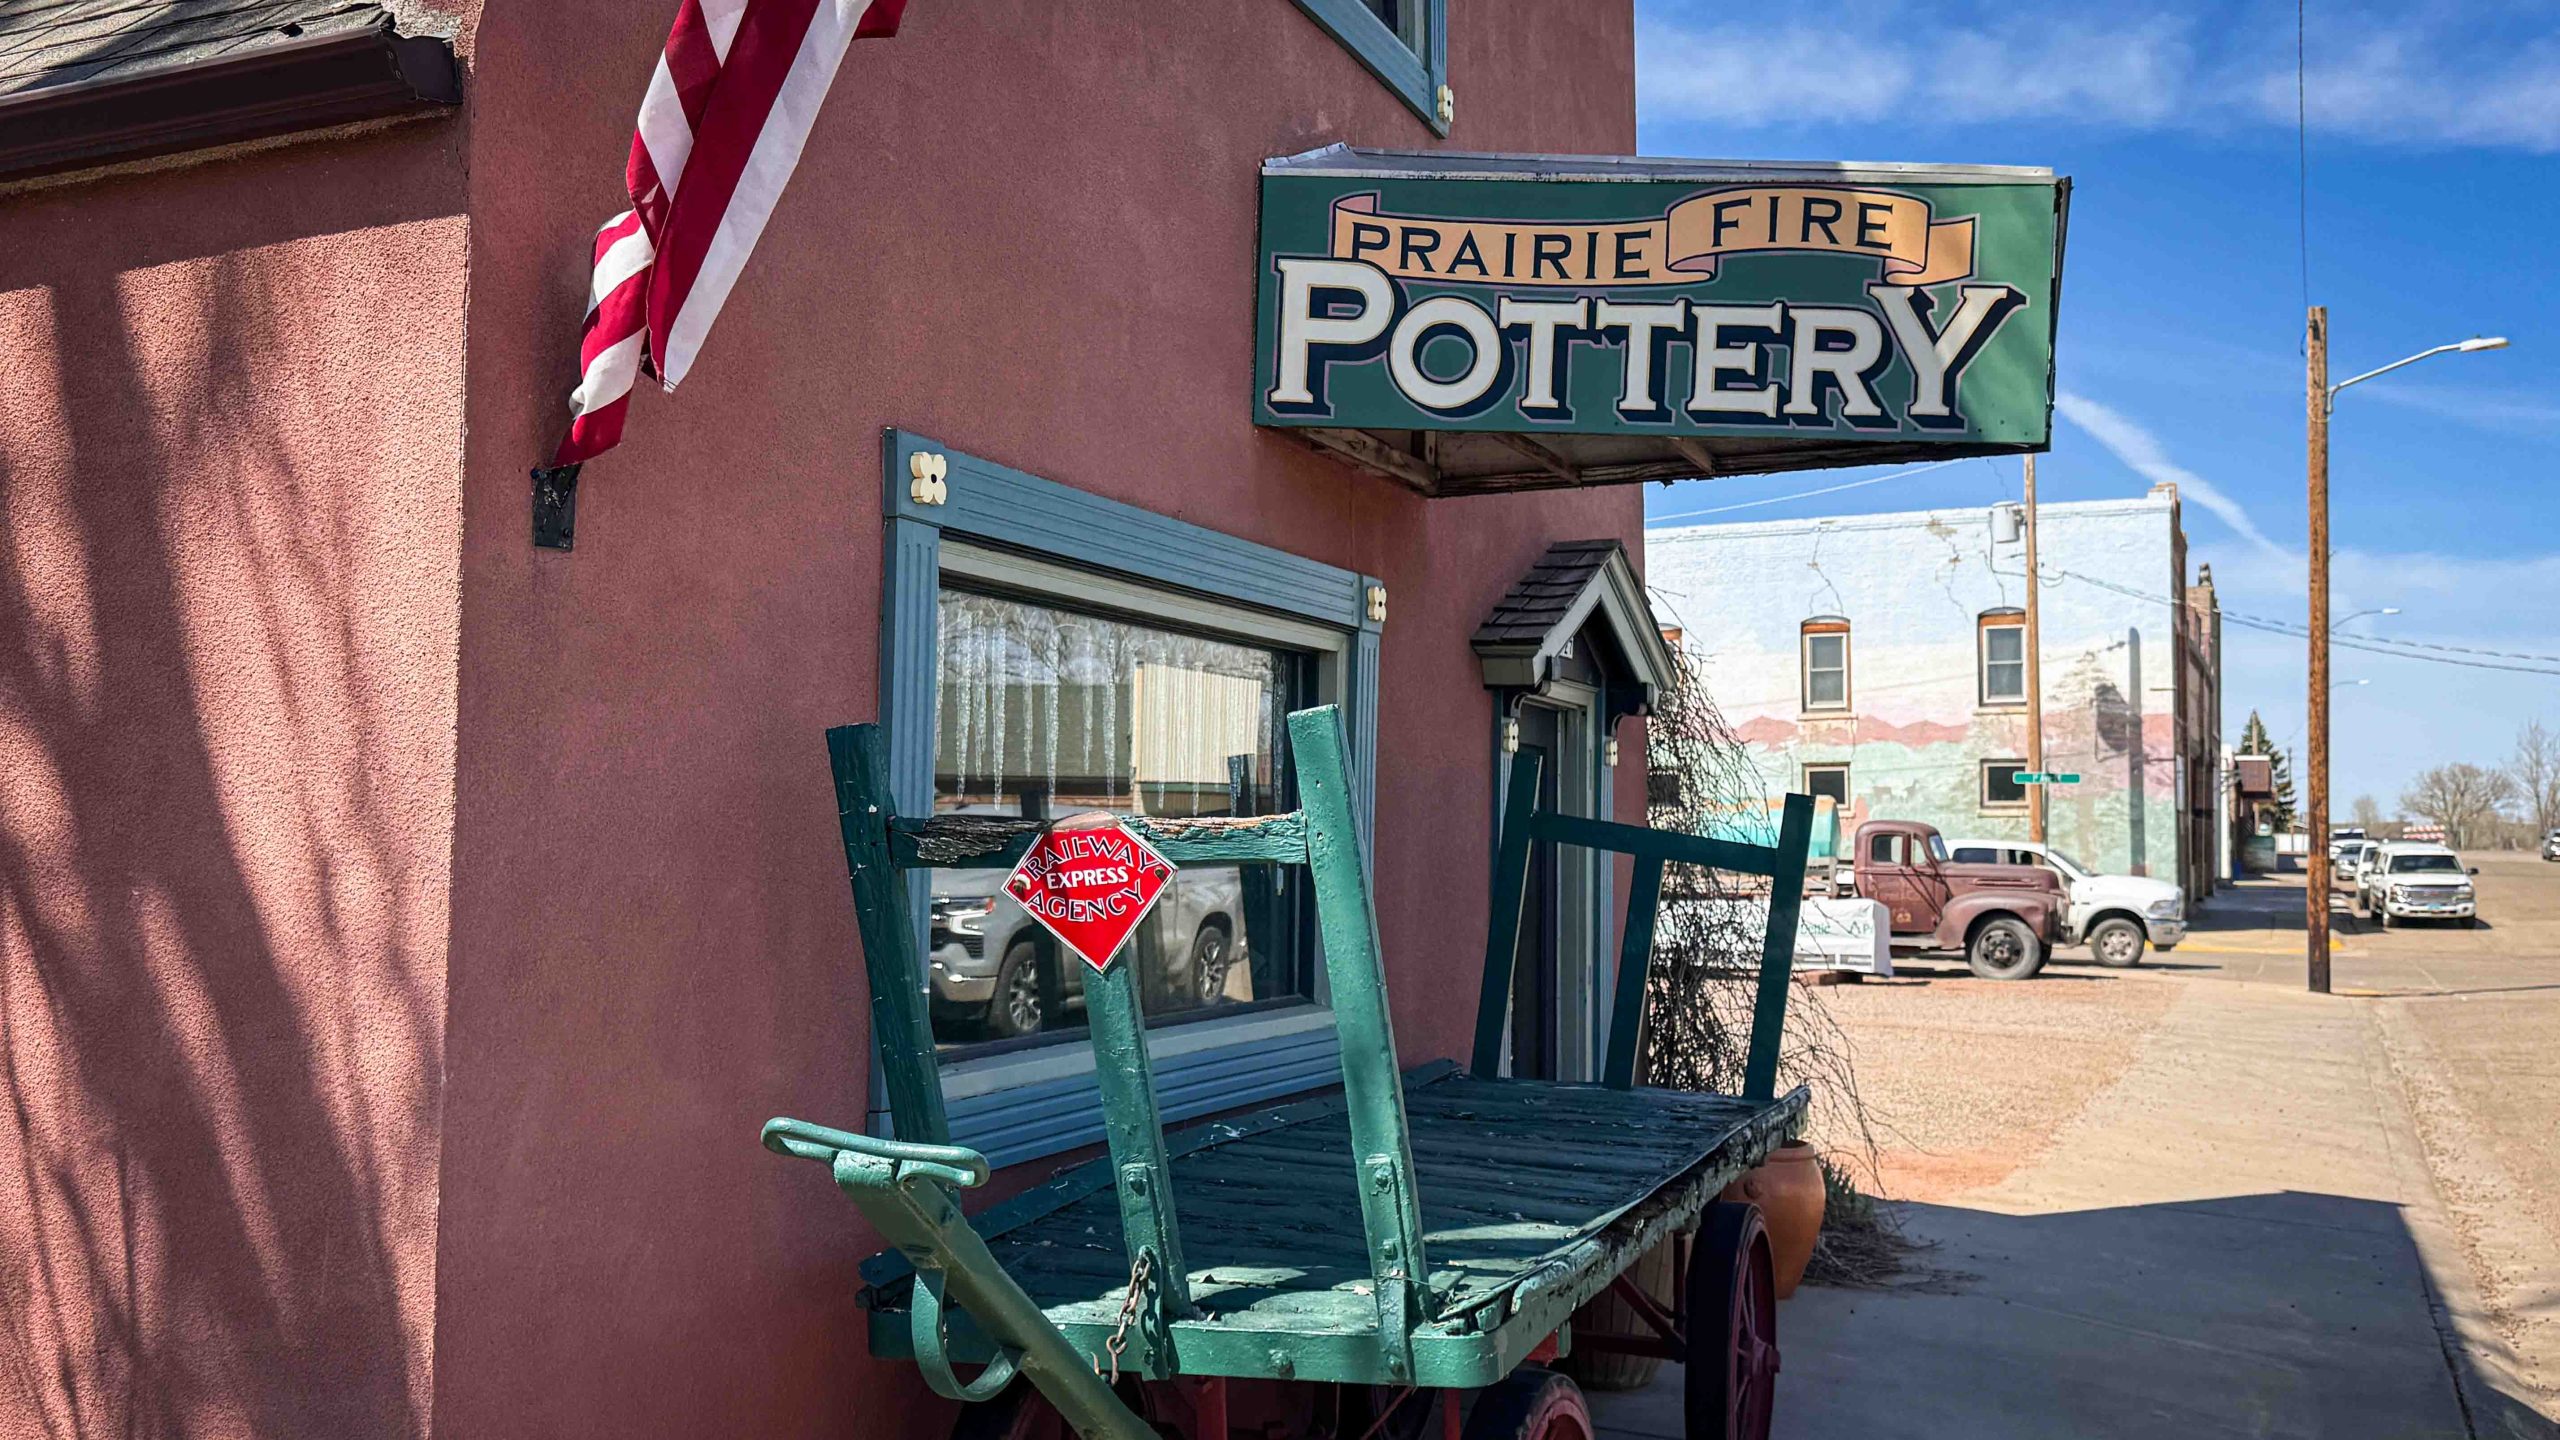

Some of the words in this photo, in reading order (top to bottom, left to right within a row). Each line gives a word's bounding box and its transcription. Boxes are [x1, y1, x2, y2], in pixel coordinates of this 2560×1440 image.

[1351, 220, 1652, 280] PRAIRIE
[1711, 195, 1894, 251] FIRE
[1268, 256, 2027, 428] POTTERY
[1025, 835, 1160, 881] RAILWAY
[1046, 866, 1129, 889] EXPRESS
[1026, 878, 1145, 922] AGENCY
